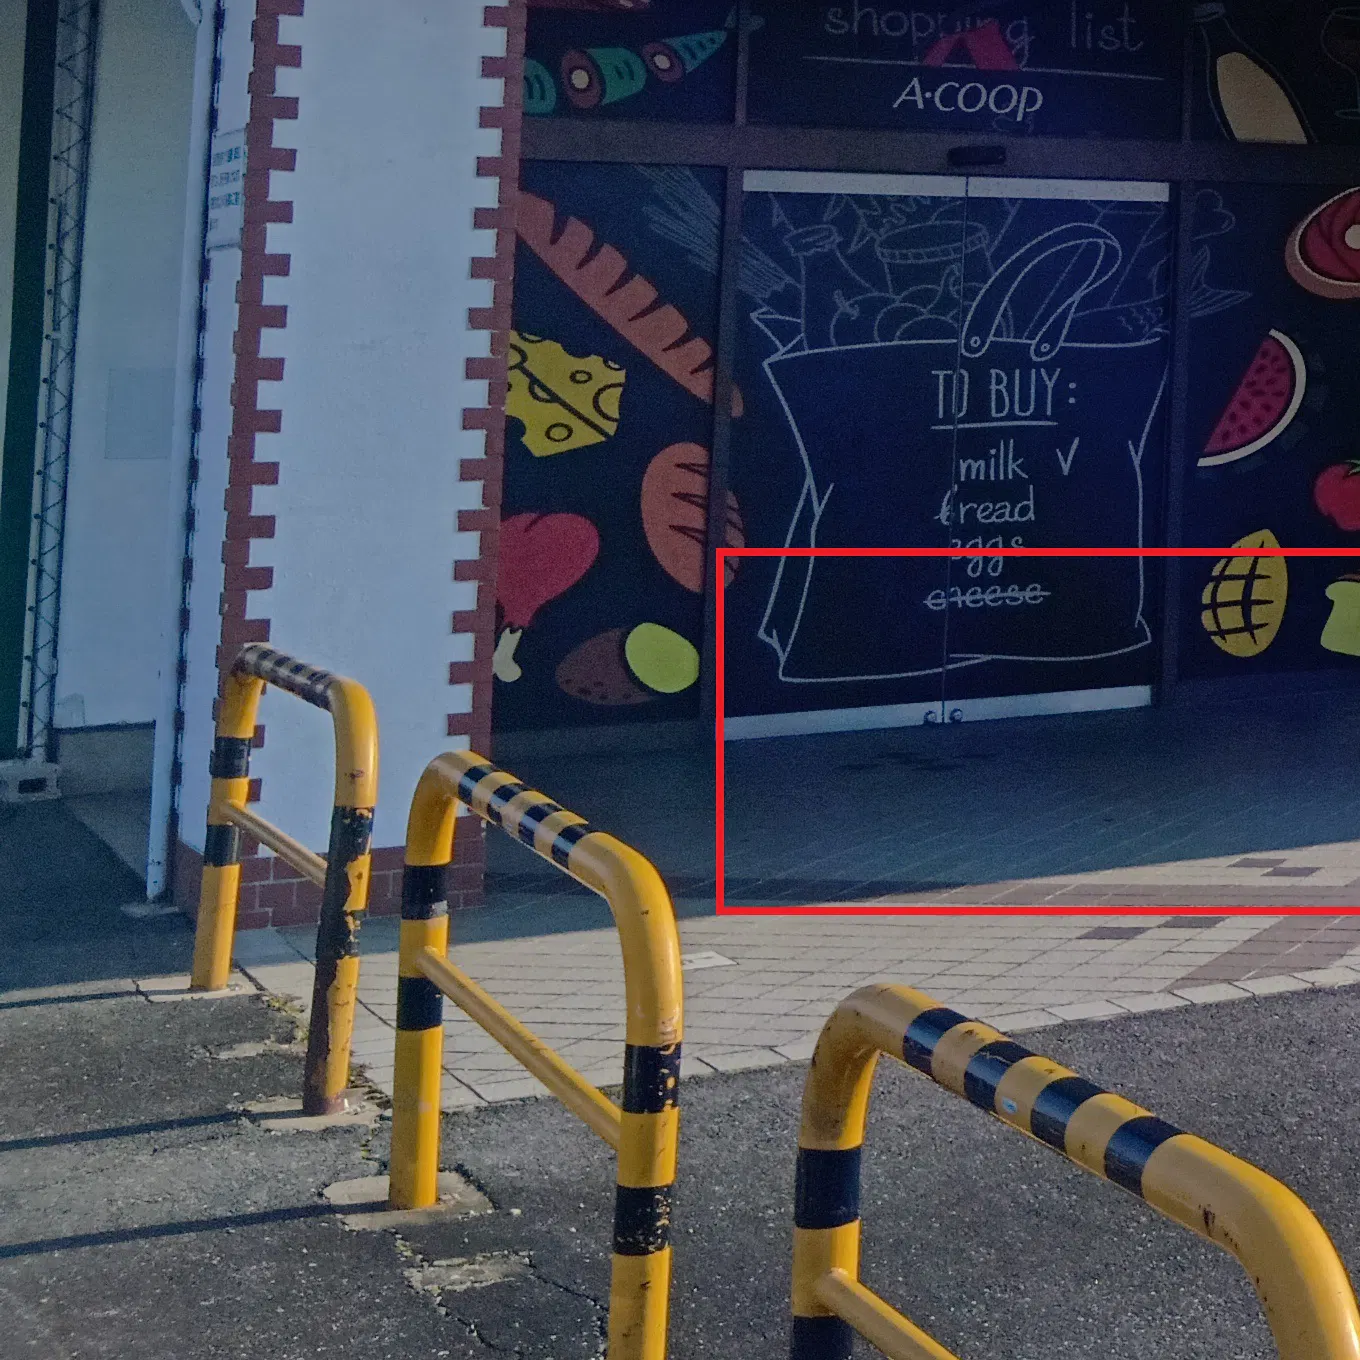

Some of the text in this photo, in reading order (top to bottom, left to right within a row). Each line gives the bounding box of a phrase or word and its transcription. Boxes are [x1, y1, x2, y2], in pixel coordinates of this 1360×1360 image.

[1070, 0, 1145, 52] list
[930, 367, 971, 419] TO
[959, 437, 1029, 481] milk
